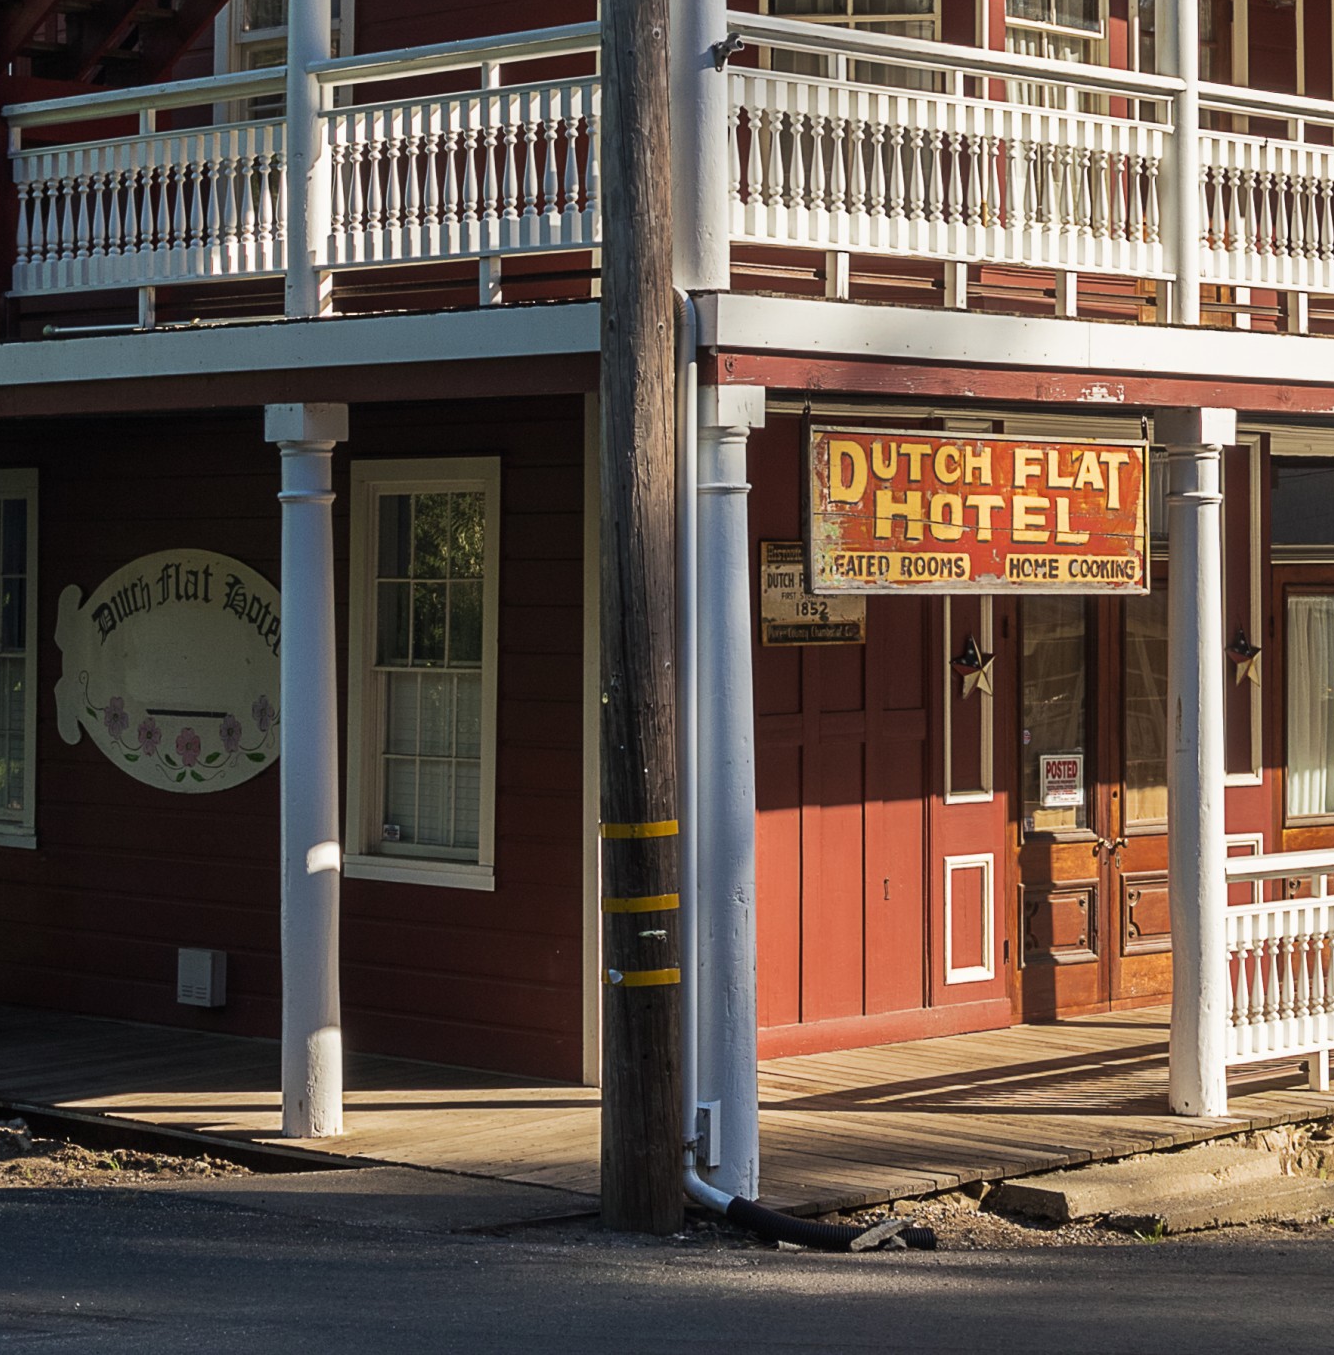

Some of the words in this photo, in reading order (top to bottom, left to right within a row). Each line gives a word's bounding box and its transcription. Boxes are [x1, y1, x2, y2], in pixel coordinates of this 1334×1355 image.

[827, 440, 992, 504] DUTCH
[1012, 448, 1129, 511] FLAT
[872, 489, 1091, 545] HOTEL
[821, 554, 890, 578] EATED
[899, 555, 966, 579] ROOMS
[1008, 557, 1060, 580] HOME
[1067, 558, 1137, 581] COOKING
[767, 572, 795, 589] DUTCH
[796, 602, 829, 617] 1852
[1045, 760, 1078, 780] POSTED
